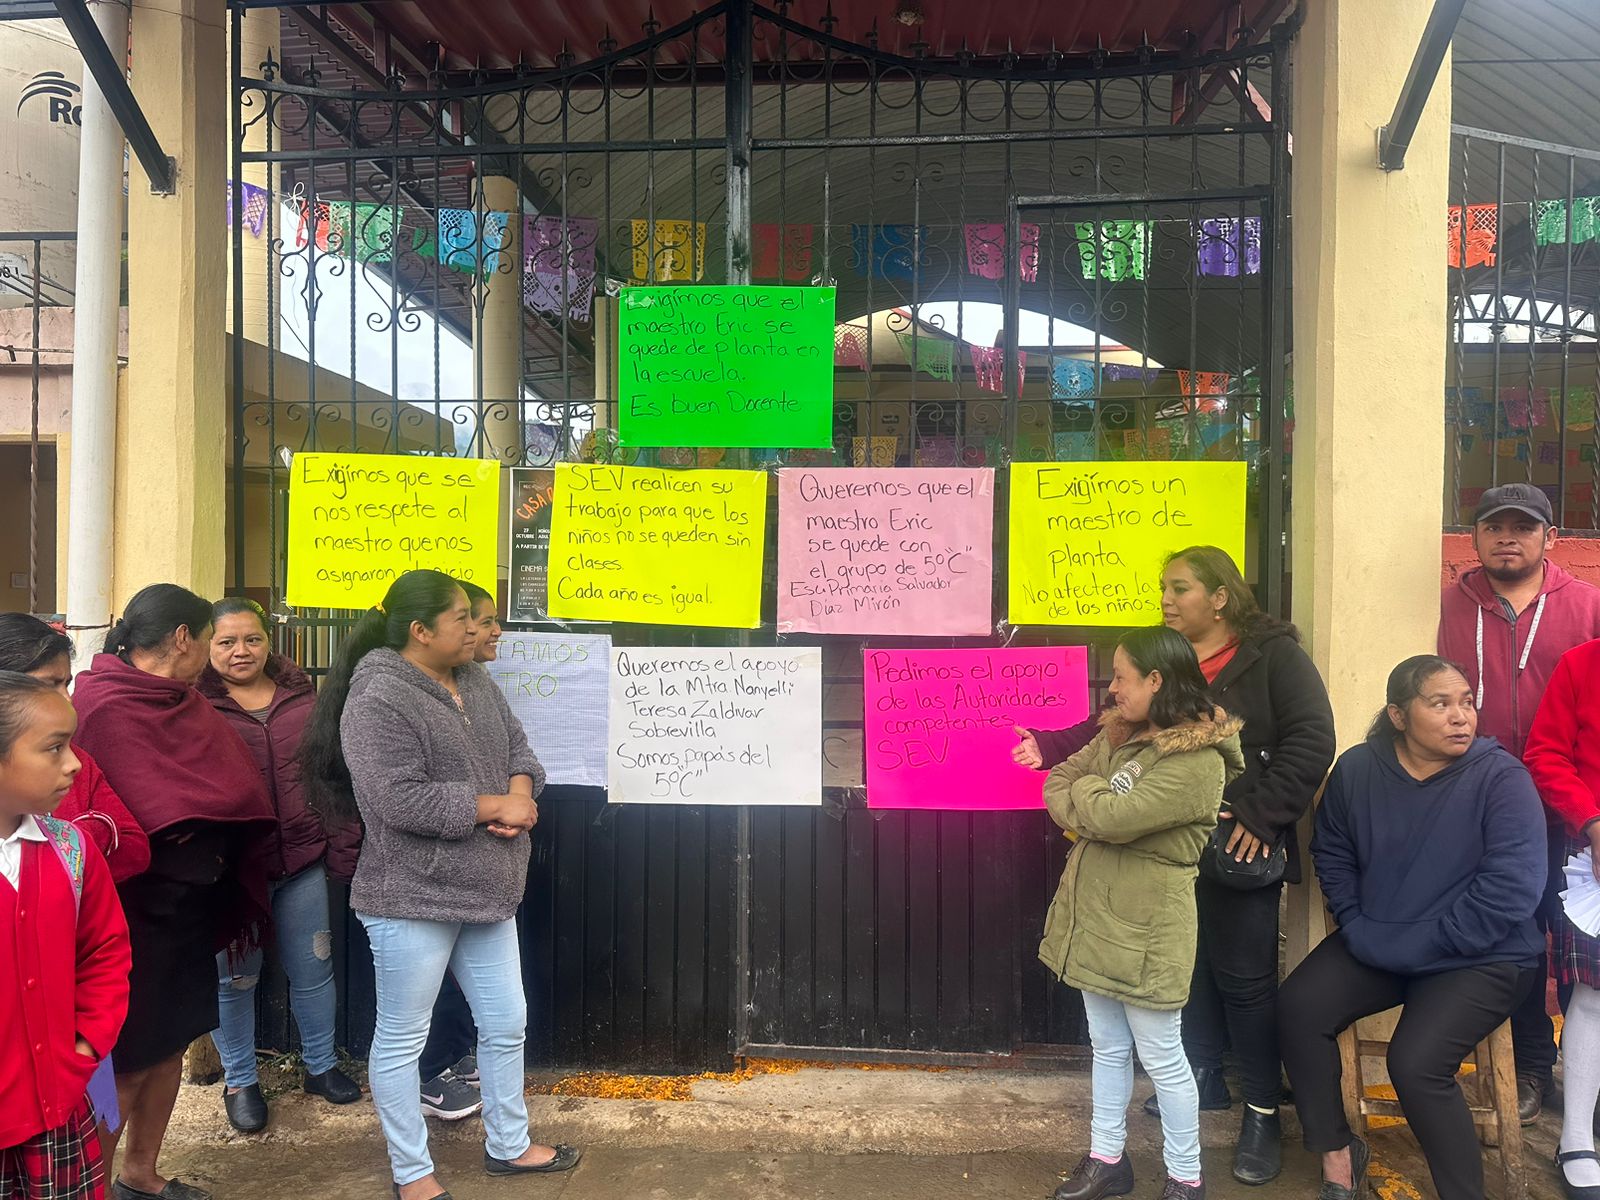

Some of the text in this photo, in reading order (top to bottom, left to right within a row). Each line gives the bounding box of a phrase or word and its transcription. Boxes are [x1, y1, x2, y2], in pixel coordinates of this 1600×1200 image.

[733, 293, 773, 312] que
[781, 290, 804, 310] el
[628, 312, 796, 336] maestro Eric se
[629, 338, 820, 362] quede de planta en
[633, 361, 651, 383] la
[631, 391, 801, 417] Es buen Docente
[396, 470, 432, 493] que
[441, 472, 475, 488] se
[568, 465, 733, 494] SEV realicen su
[800, 474, 974, 502] Queremos que el
[1152, 477, 1187, 496] un
[313, 492, 467, 526] nos respete al
[516, 493, 548, 520] CASA
[565, 493, 631, 528] trabajo
[639, 506, 677, 523] para
[684, 506, 715, 526] que
[724, 501, 749, 525] los
[1048, 500, 1192, 531] maestro de
[807, 508, 933, 531] maestro Eric
[315, 527, 473, 561] maestro que nos
[568, 524, 751, 548] niños no se queden sin
[809, 534, 932, 562] se quede con
[520, 564, 543, 572] CINEMA
[1048, 540, 1126, 578] planta
[317, 566, 396, 591] asignaron
[810, 560, 827, 579] el
[837, 563, 887, 588] grupo
[895, 559, 916, 576] de
[558, 576, 604, 600] Cada
[609, 588, 638, 601] año
[643, 592, 664, 605] es
[826, 578, 893, 597] Primaria
[897, 576, 951, 591] Salvador
[1023, 580, 1049, 605] No
[1054, 571, 1127, 598] afecten
[854, 595, 901, 612] Mirón
[1048, 605, 1070, 618] de
[1077, 599, 1101, 615] los
[617, 651, 799, 680] Queremos el apoyo
[871, 652, 1059, 686] Pedimos el apoyo
[625, 681, 650, 699] de
[659, 678, 680, 697] la
[876, 683, 1068, 712] de las Autoridades
[626, 701, 686, 718] Teresa
[628, 720, 717, 738] Sobrevilla
[740, 744, 771, 768] del
[877, 737, 949, 770] SEV
